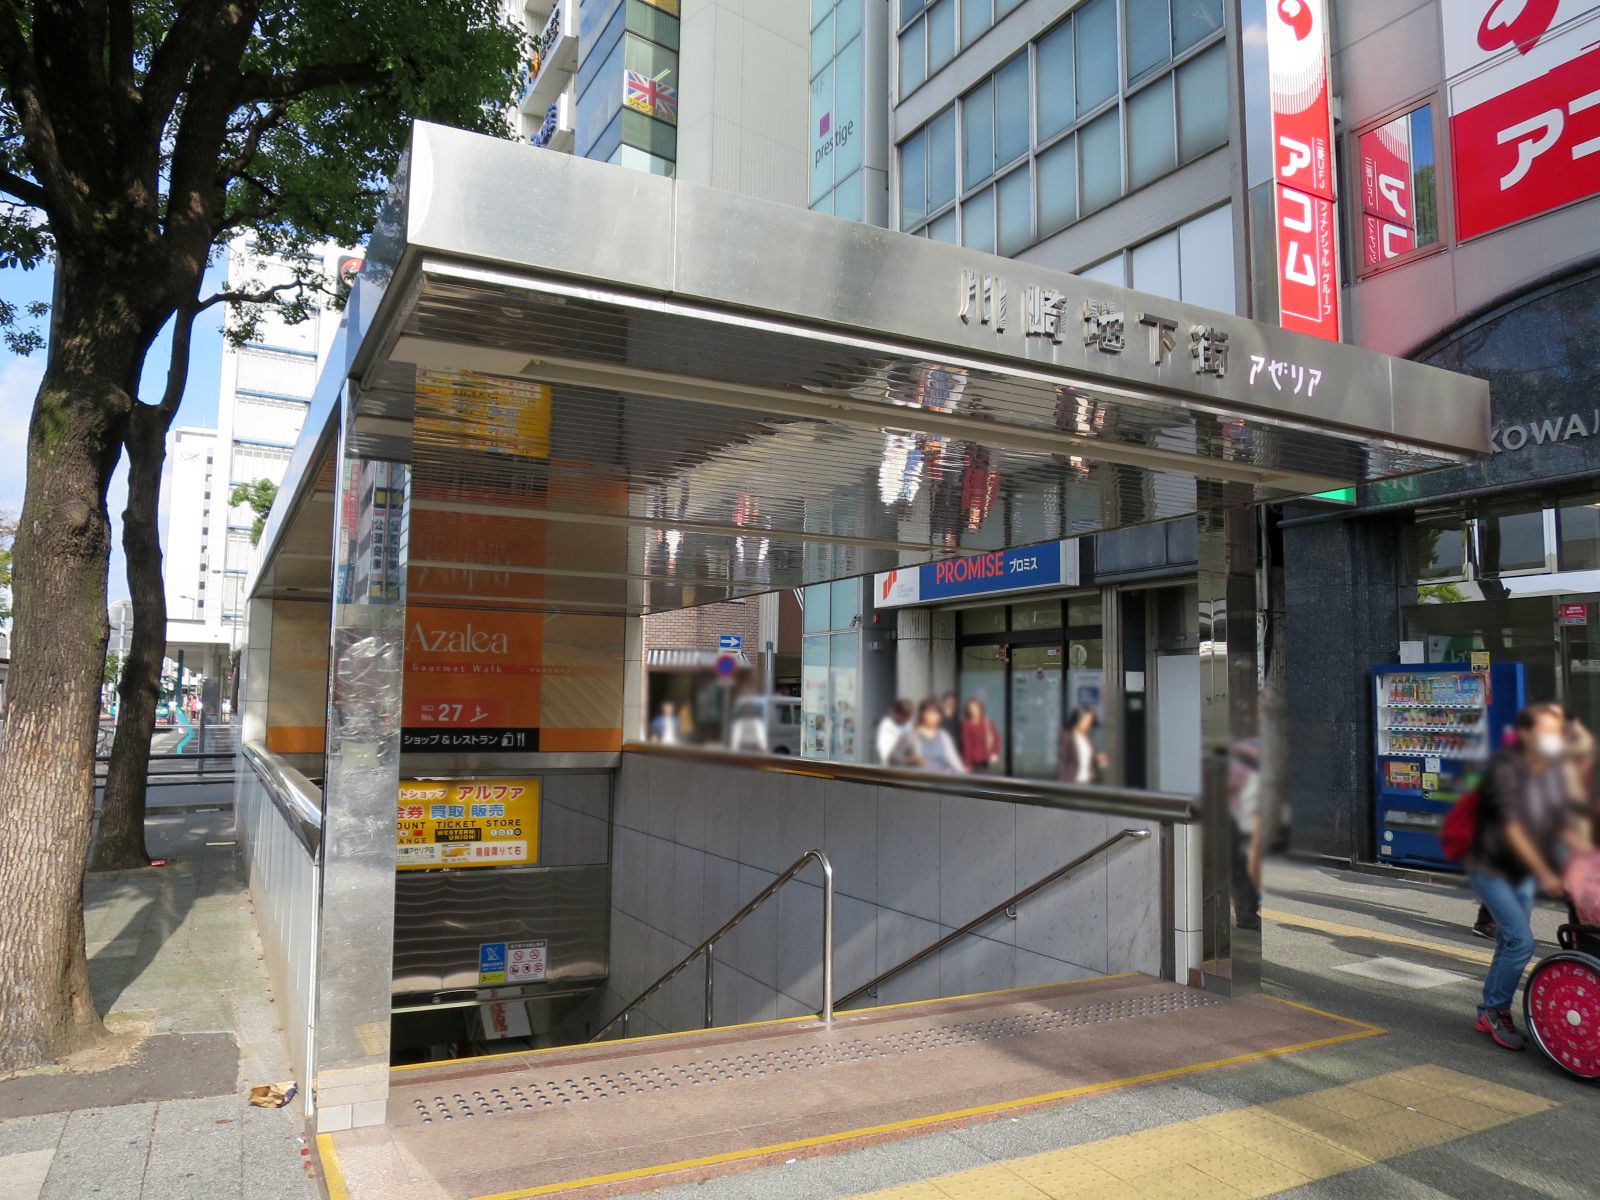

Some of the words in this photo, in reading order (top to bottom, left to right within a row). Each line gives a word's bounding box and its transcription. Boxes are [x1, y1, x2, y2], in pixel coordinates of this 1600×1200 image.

[815, 121, 854, 169] prestige
[1279, 135, 1316, 287] アコム
[957, 268, 1230, 379] 川崎地下街
[1249, 355, 1323, 397] アゼリア
[935, 551, 1005, 585] PROMISE
[1009, 556, 1038, 574] プロミス
[405, 621, 508, 654] Azalea
[412, 662, 465, 673] Gourmet
[472, 663, 502, 673] Walk
[438, 704, 463, 721] 27
[404, 734, 440, 746] ショップ
[442, 735, 450, 745] &
[453, 735, 498, 745] レストラン
[458, 784, 524, 800] アルファ
[431, 804, 465, 819] 買取
[471, 803, 505, 818] 販売
[437, 820, 477, 829] TICKET
[486, 819, 521, 828] STORE
